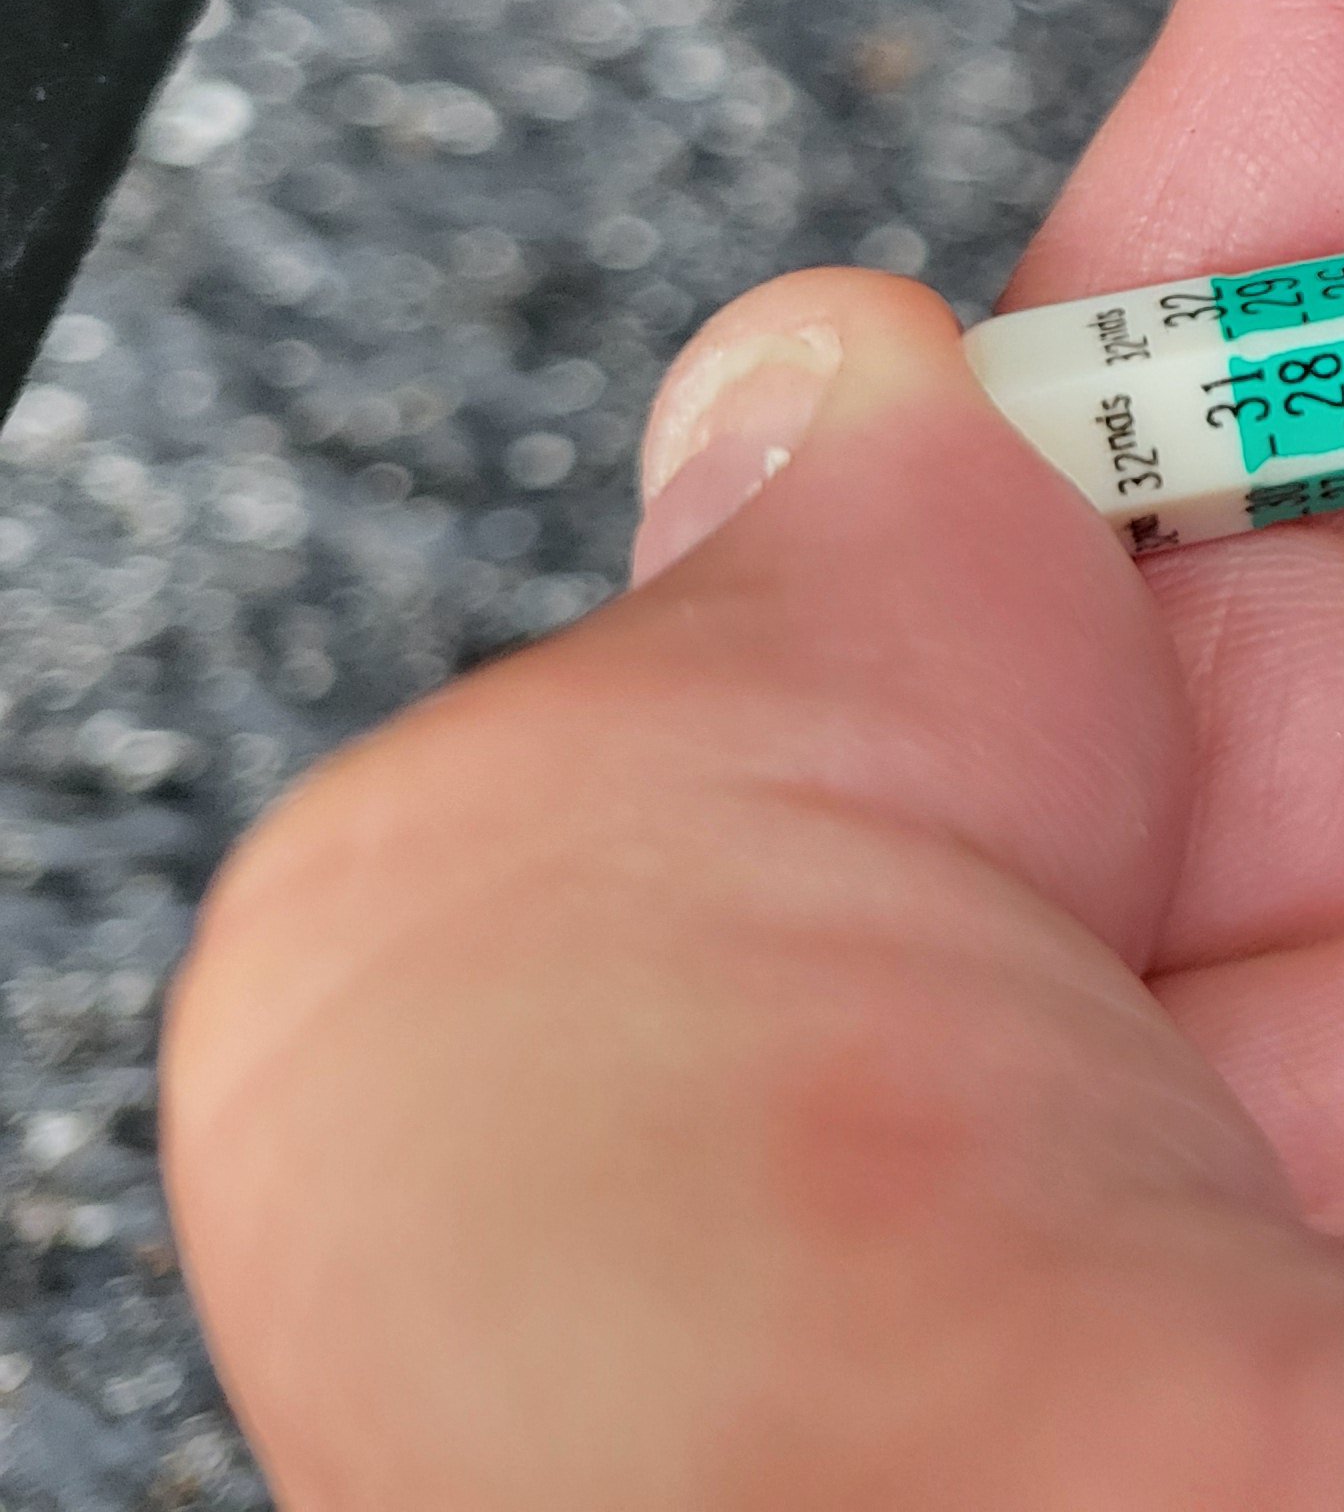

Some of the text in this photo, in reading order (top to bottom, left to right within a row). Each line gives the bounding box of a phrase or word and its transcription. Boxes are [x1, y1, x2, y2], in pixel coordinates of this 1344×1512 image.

[1159, 292, 1228, 328] 32
[1236, 277, 1304, 314] 29
[1201, 369, 1269, 428] 31
[1096, 393, 1164, 496] 32nds
